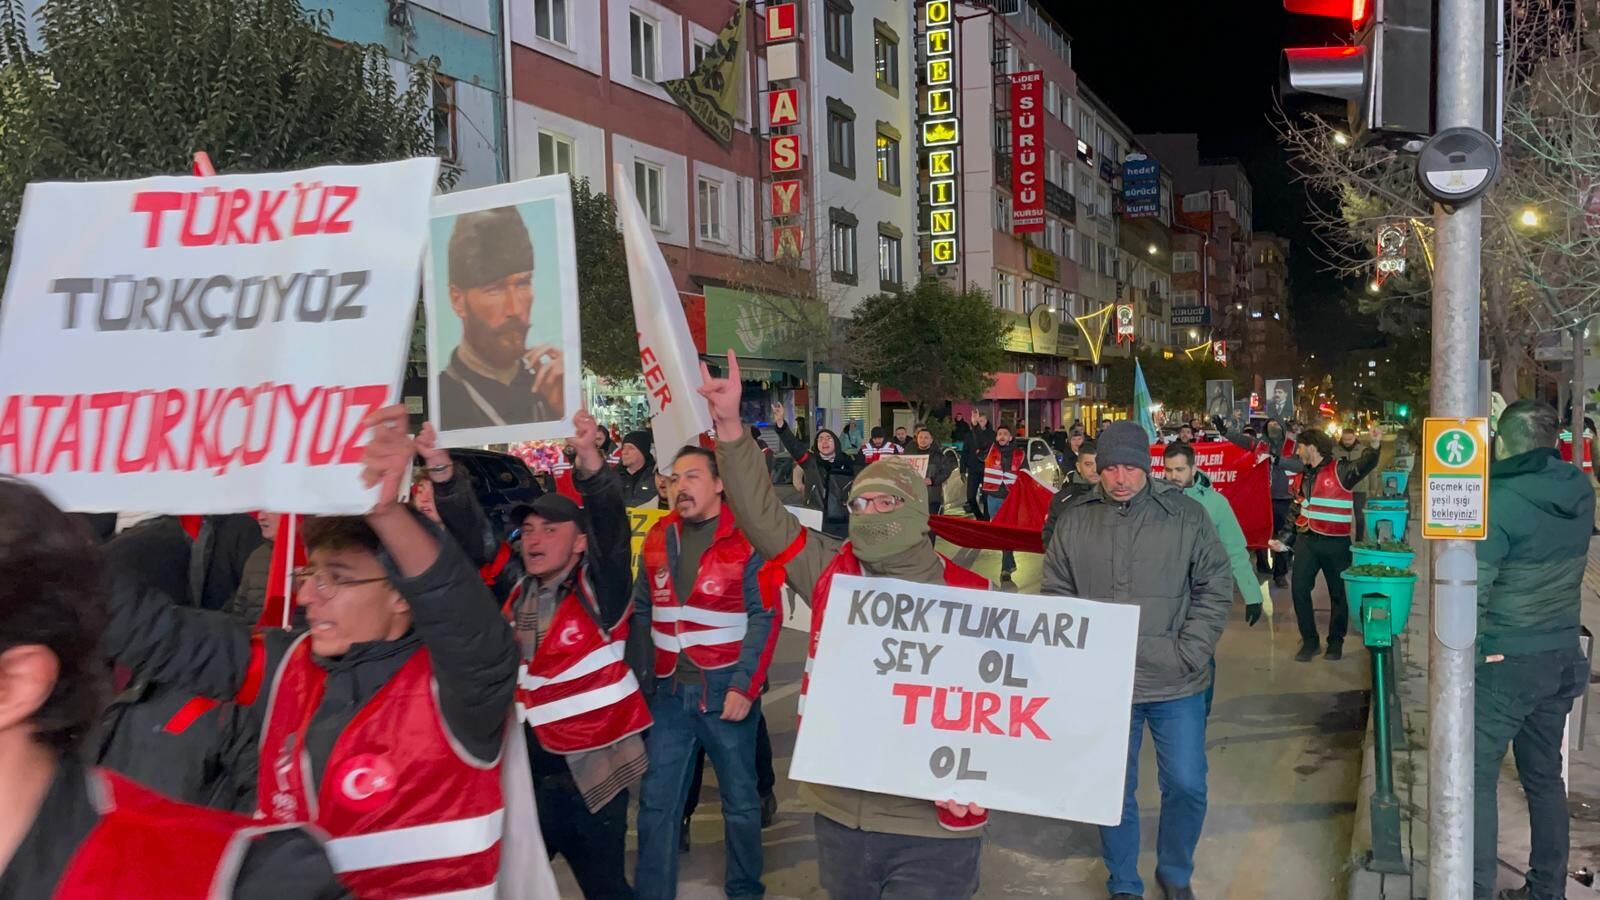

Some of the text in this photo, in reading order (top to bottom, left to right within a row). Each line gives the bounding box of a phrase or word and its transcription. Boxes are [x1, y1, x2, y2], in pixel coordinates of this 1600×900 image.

[1020, 83, 1033, 91] 32
[929, 3, 951, 261] OTEL KING
[1019, 96, 1036, 204] SÜRÜCÜ
[772, 92, 801, 261] ASYA
[1127, 166, 1155, 175] hedef
[131, 181, 360, 248] TÜRKÜZ
[1014, 209, 1043, 217] KURSU
[1126, 204, 1156, 213] kursu
[51, 269, 371, 336] TÜRKÇÜYÜZ
[0, 382, 390, 476] ATATÜRKÇÜYÜZ
[1429, 481, 1480, 493] Geçmek için
[1432, 496, 1450, 506] yeşil
[848, 589, 1090, 650] KORKTUKLARI
[873, 637, 1028, 688] ŞEY OL
[892, 683, 1052, 741] TÜRK
[929, 746, 987, 781] OL
